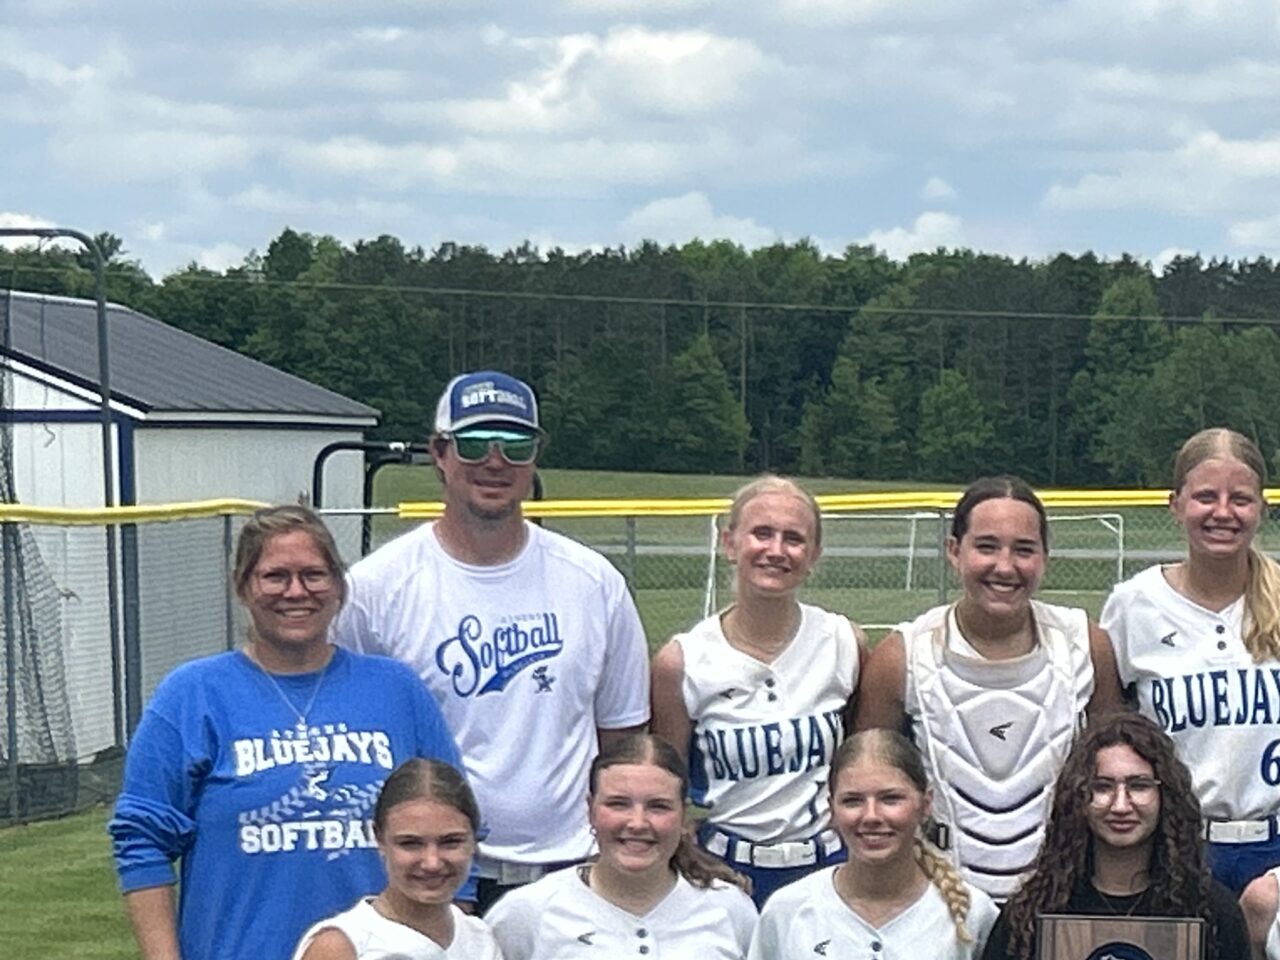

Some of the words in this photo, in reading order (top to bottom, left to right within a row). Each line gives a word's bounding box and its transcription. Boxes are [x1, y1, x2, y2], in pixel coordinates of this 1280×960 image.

[436, 611, 563, 697] Softball
[234, 731, 394, 777] BLUEJAYS
[705, 712, 843, 782] BLUEJAY
[240, 819, 381, 854] SOFTBA
